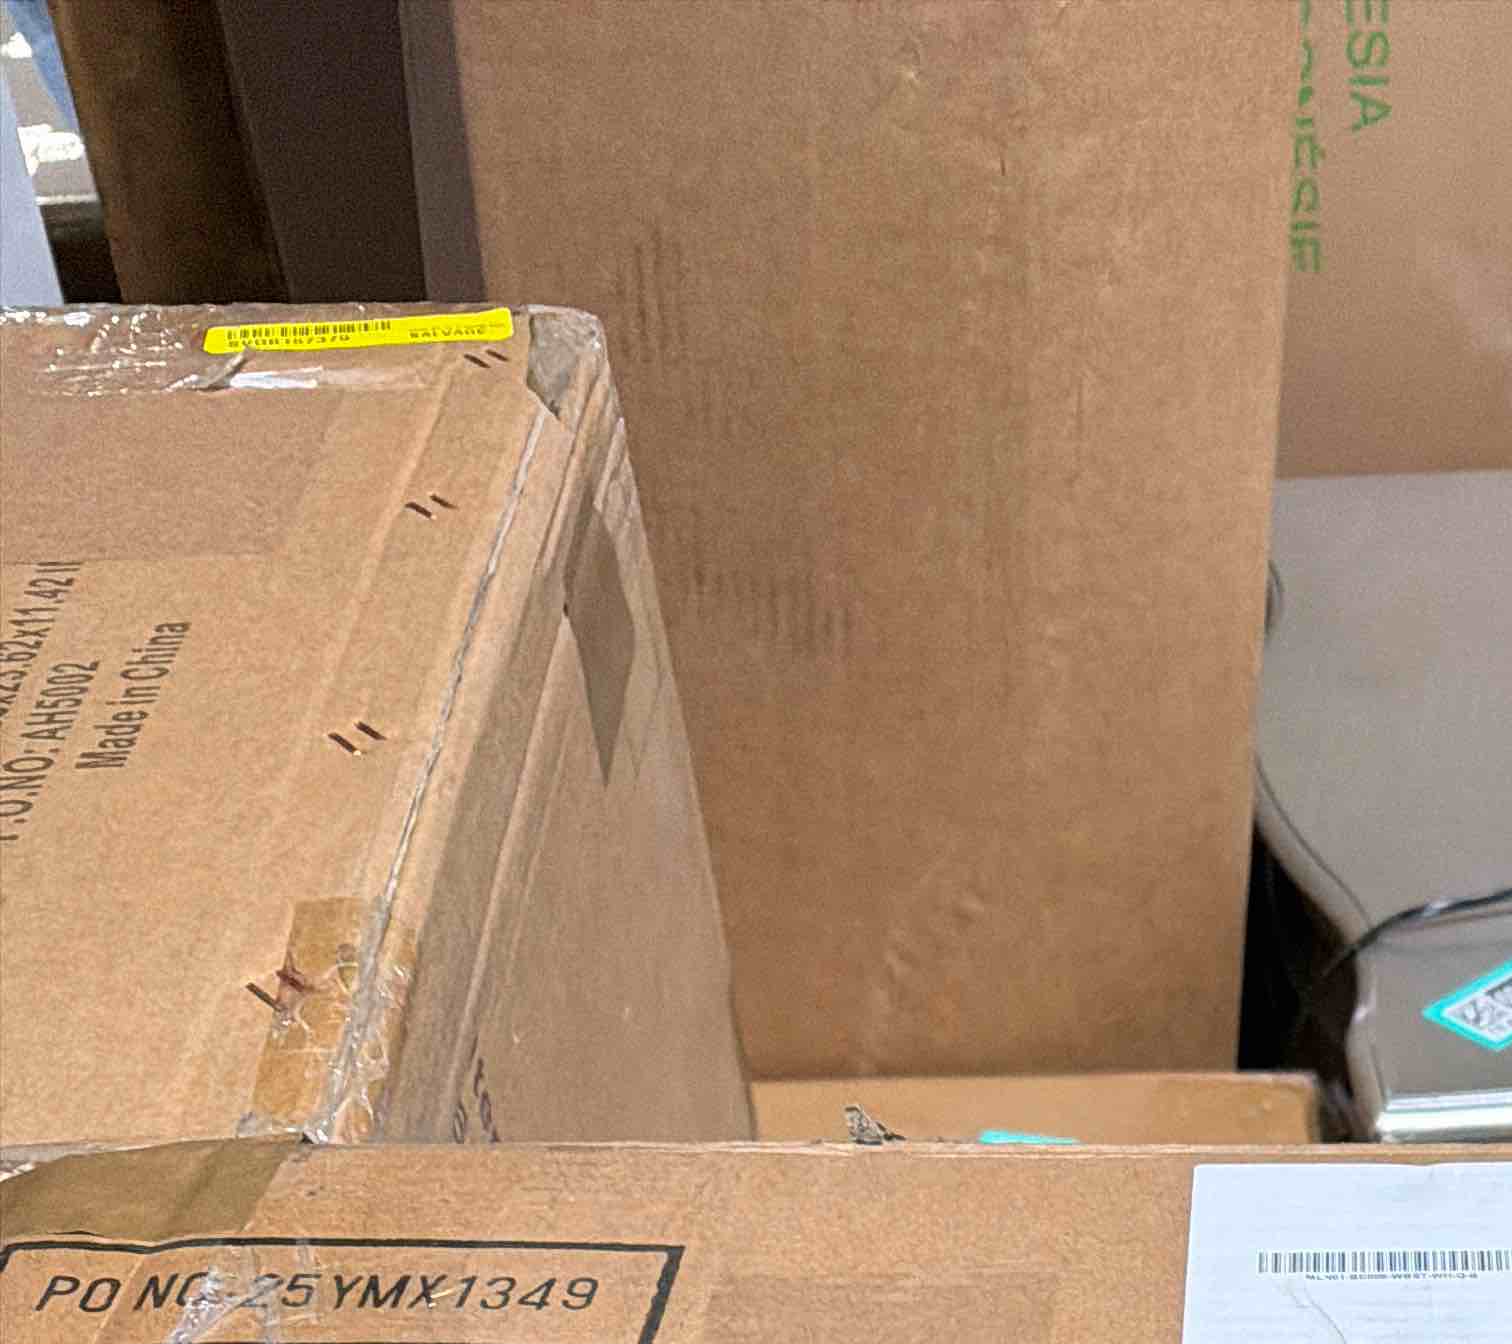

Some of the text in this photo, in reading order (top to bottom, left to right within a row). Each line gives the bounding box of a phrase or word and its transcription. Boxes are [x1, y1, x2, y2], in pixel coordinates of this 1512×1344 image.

[75, 621, 192, 770] Made in China
[34, 1275, 123, 1314] PO
